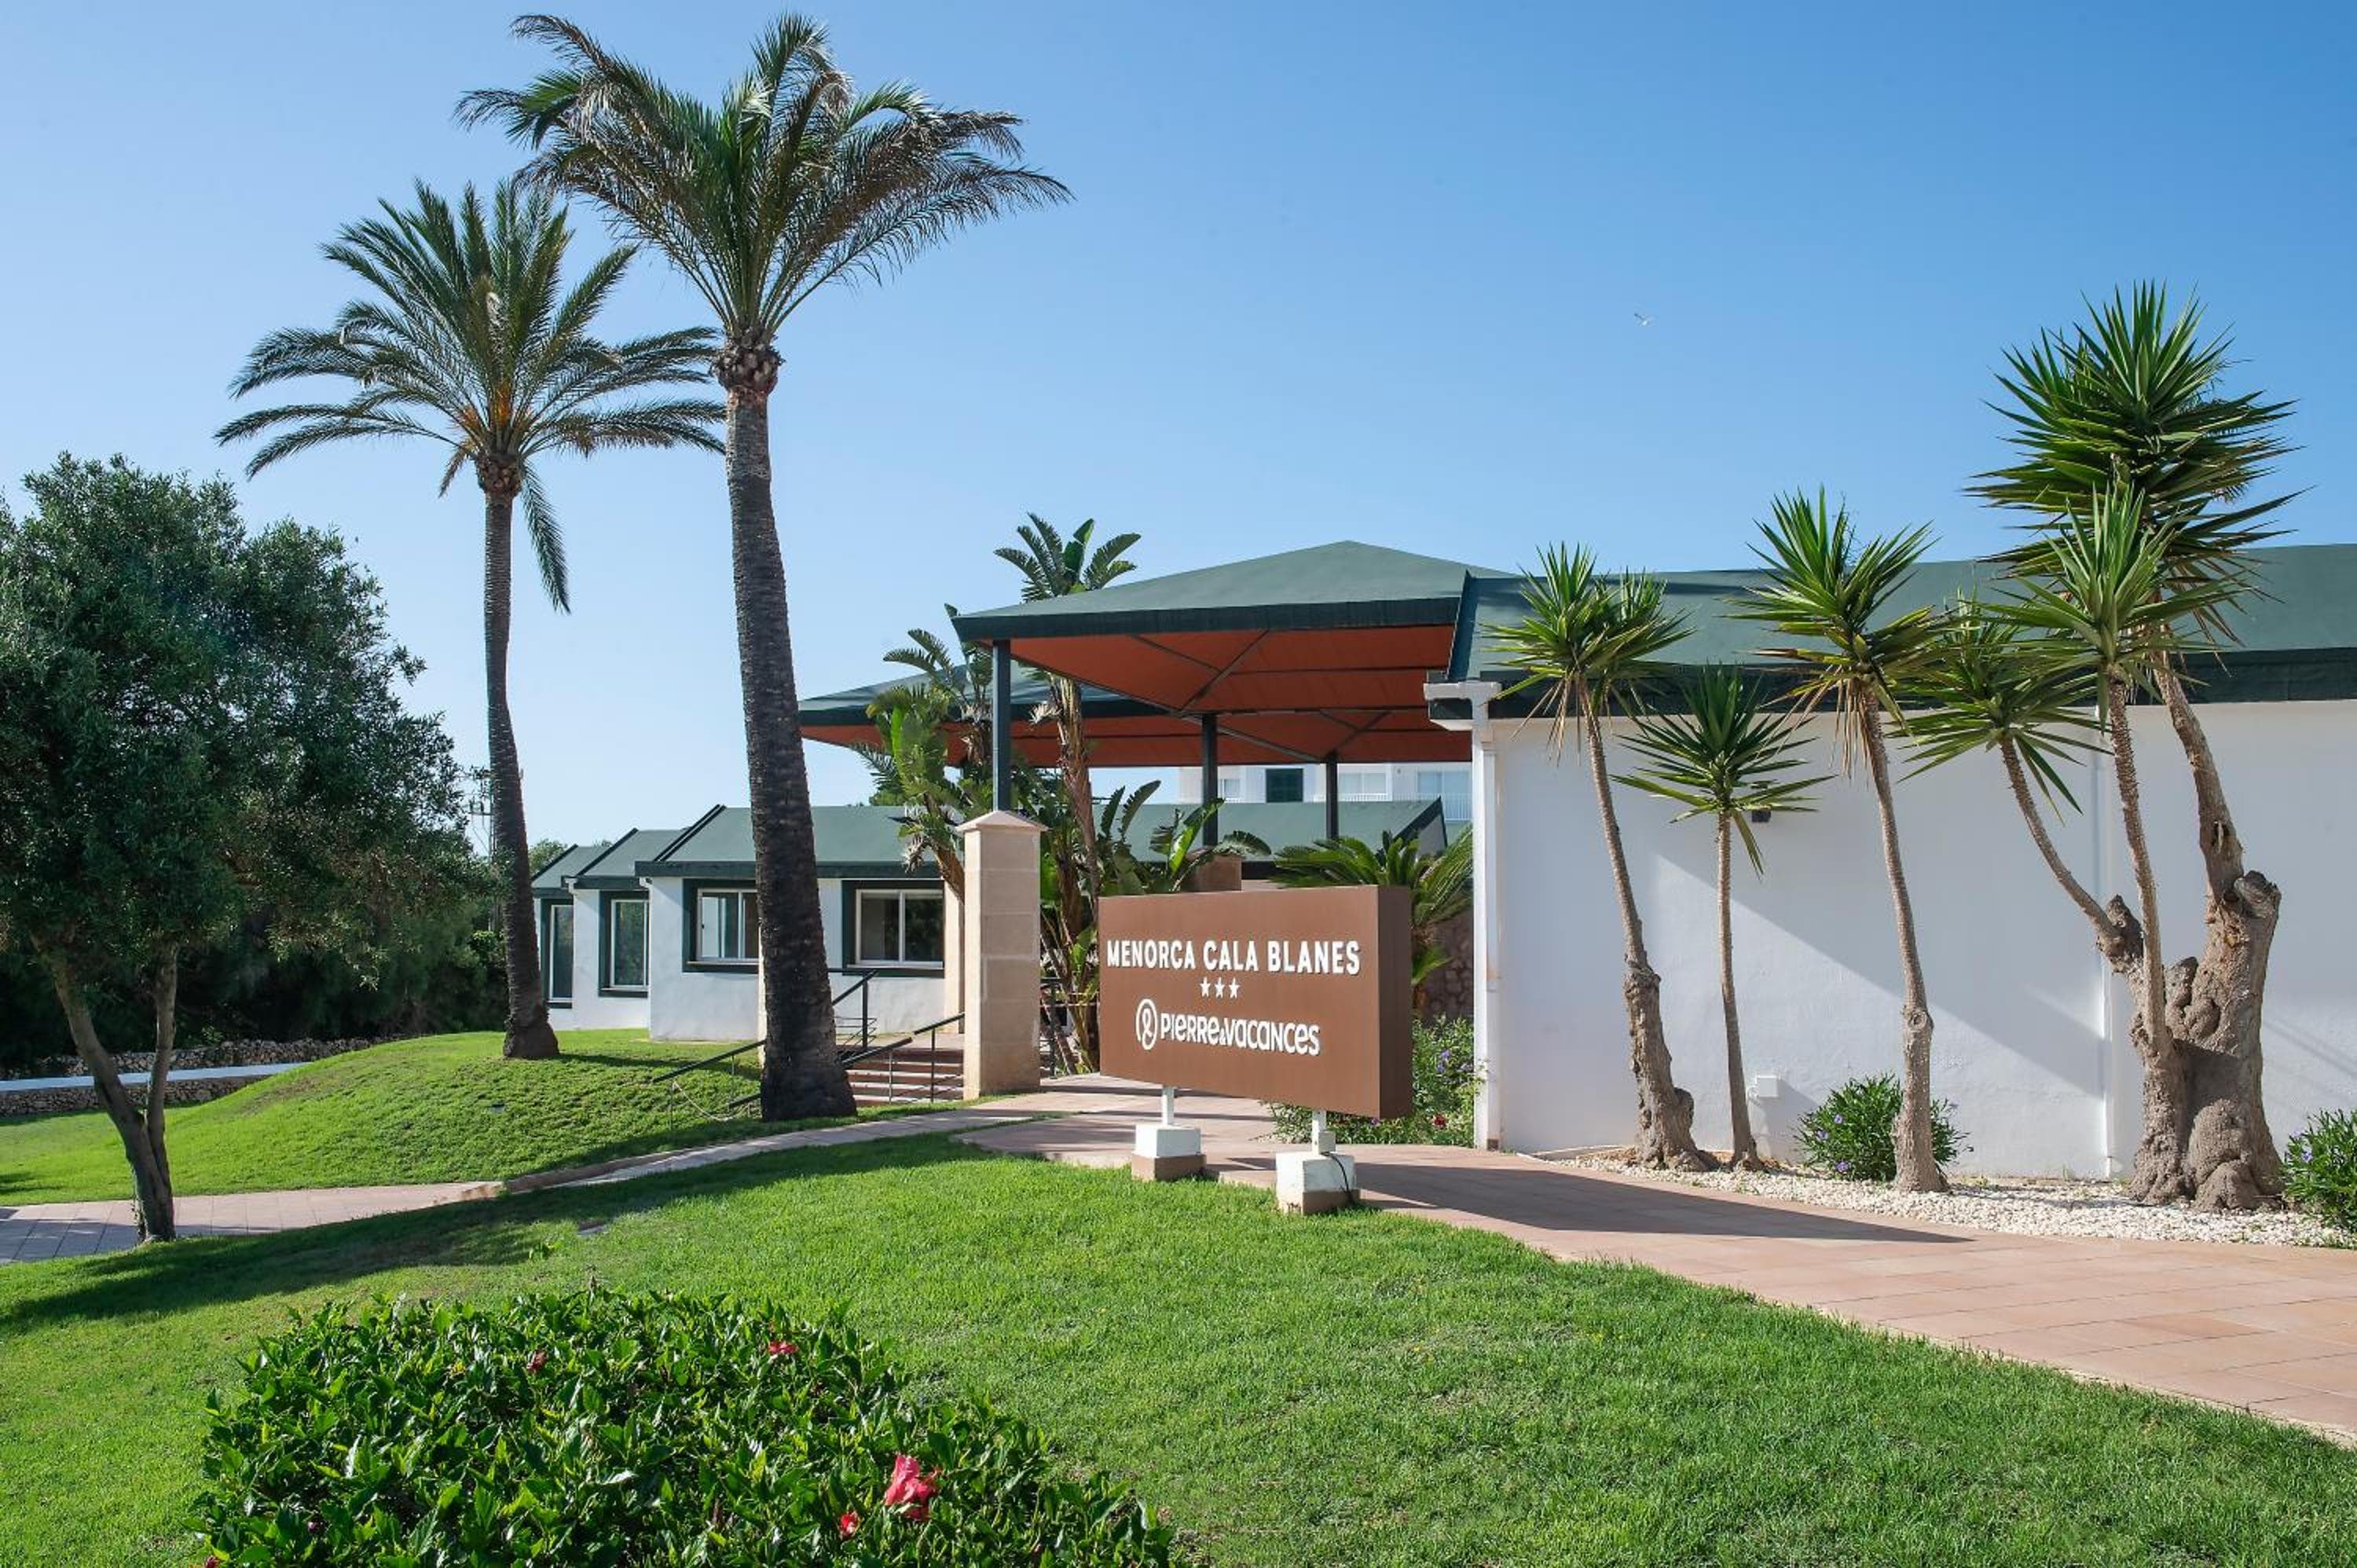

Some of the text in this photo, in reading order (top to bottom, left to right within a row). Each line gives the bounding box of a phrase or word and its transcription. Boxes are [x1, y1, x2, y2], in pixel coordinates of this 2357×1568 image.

[1107, 940, 1361, 974] MENORCA CALA BLANES
